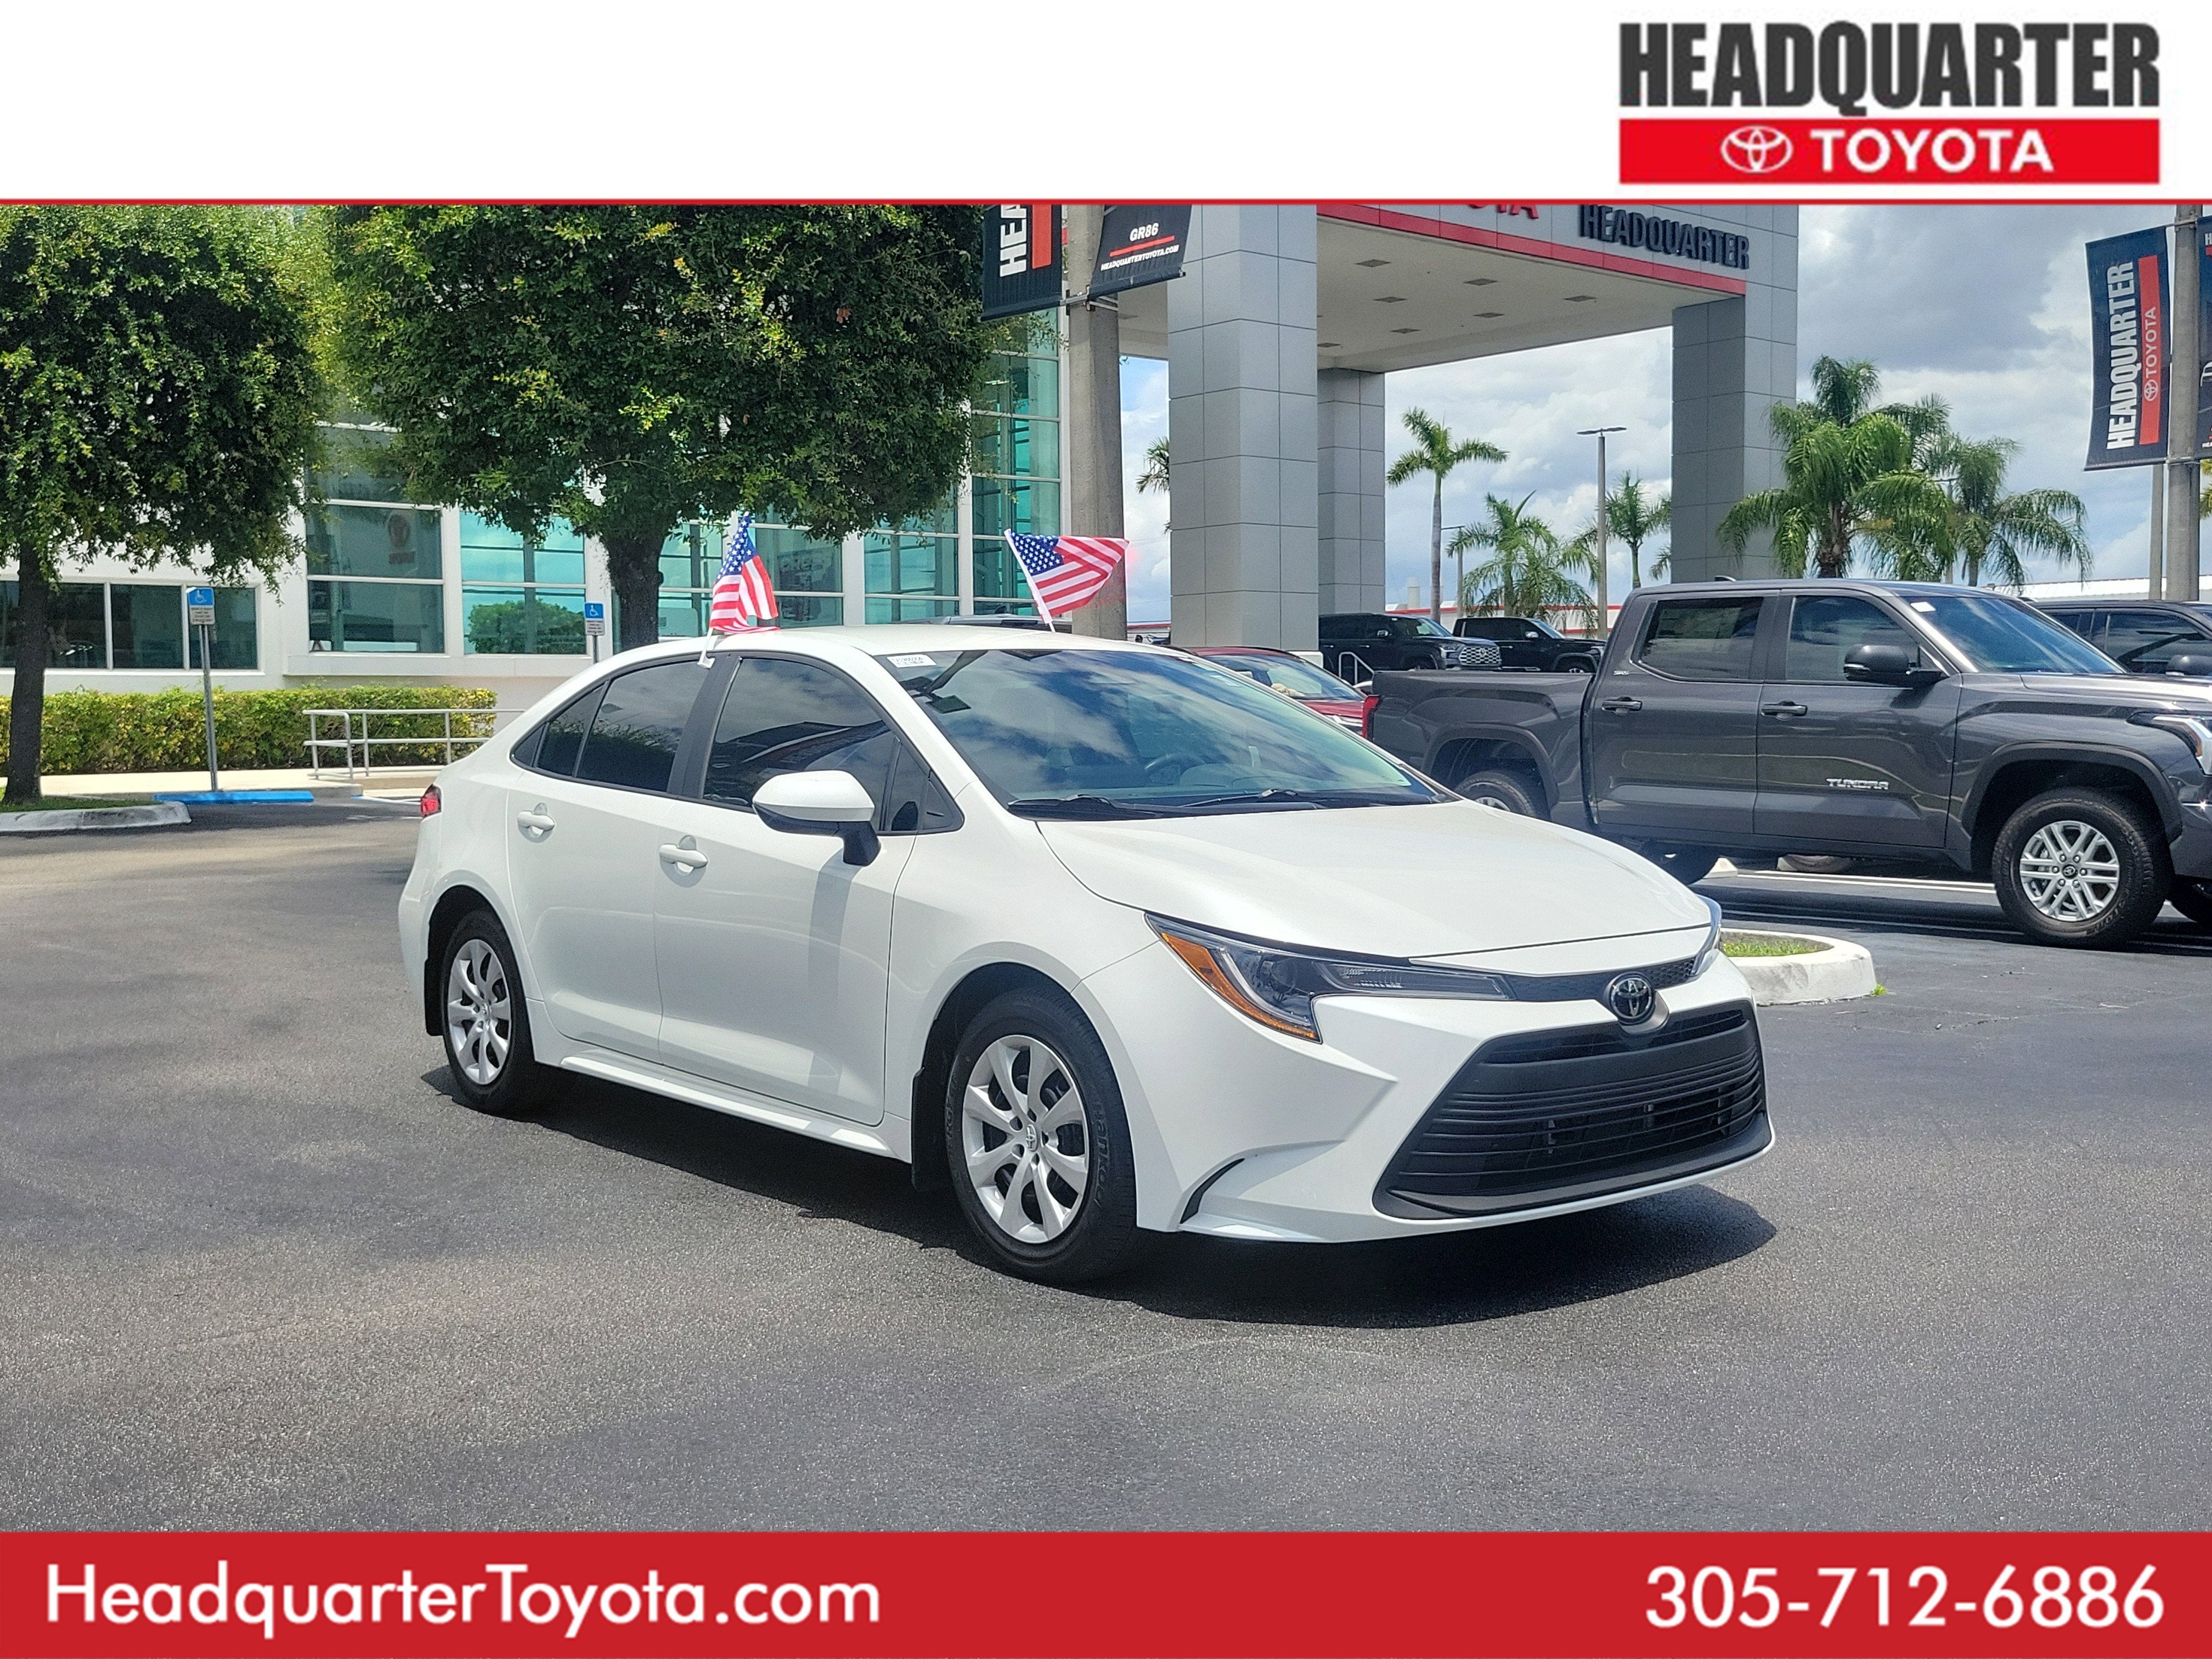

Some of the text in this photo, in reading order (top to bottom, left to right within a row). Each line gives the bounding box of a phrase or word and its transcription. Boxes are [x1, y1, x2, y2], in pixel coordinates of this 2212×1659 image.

[1130, 222, 1159, 241] GR86
[1579, 205, 1750, 269] HEADQUARTER
[2107, 261, 2141, 450] HEADQUARTER
[2144, 307, 2157, 379] TOYOTA
[1826, 778, 1889, 790] TUNDRA
